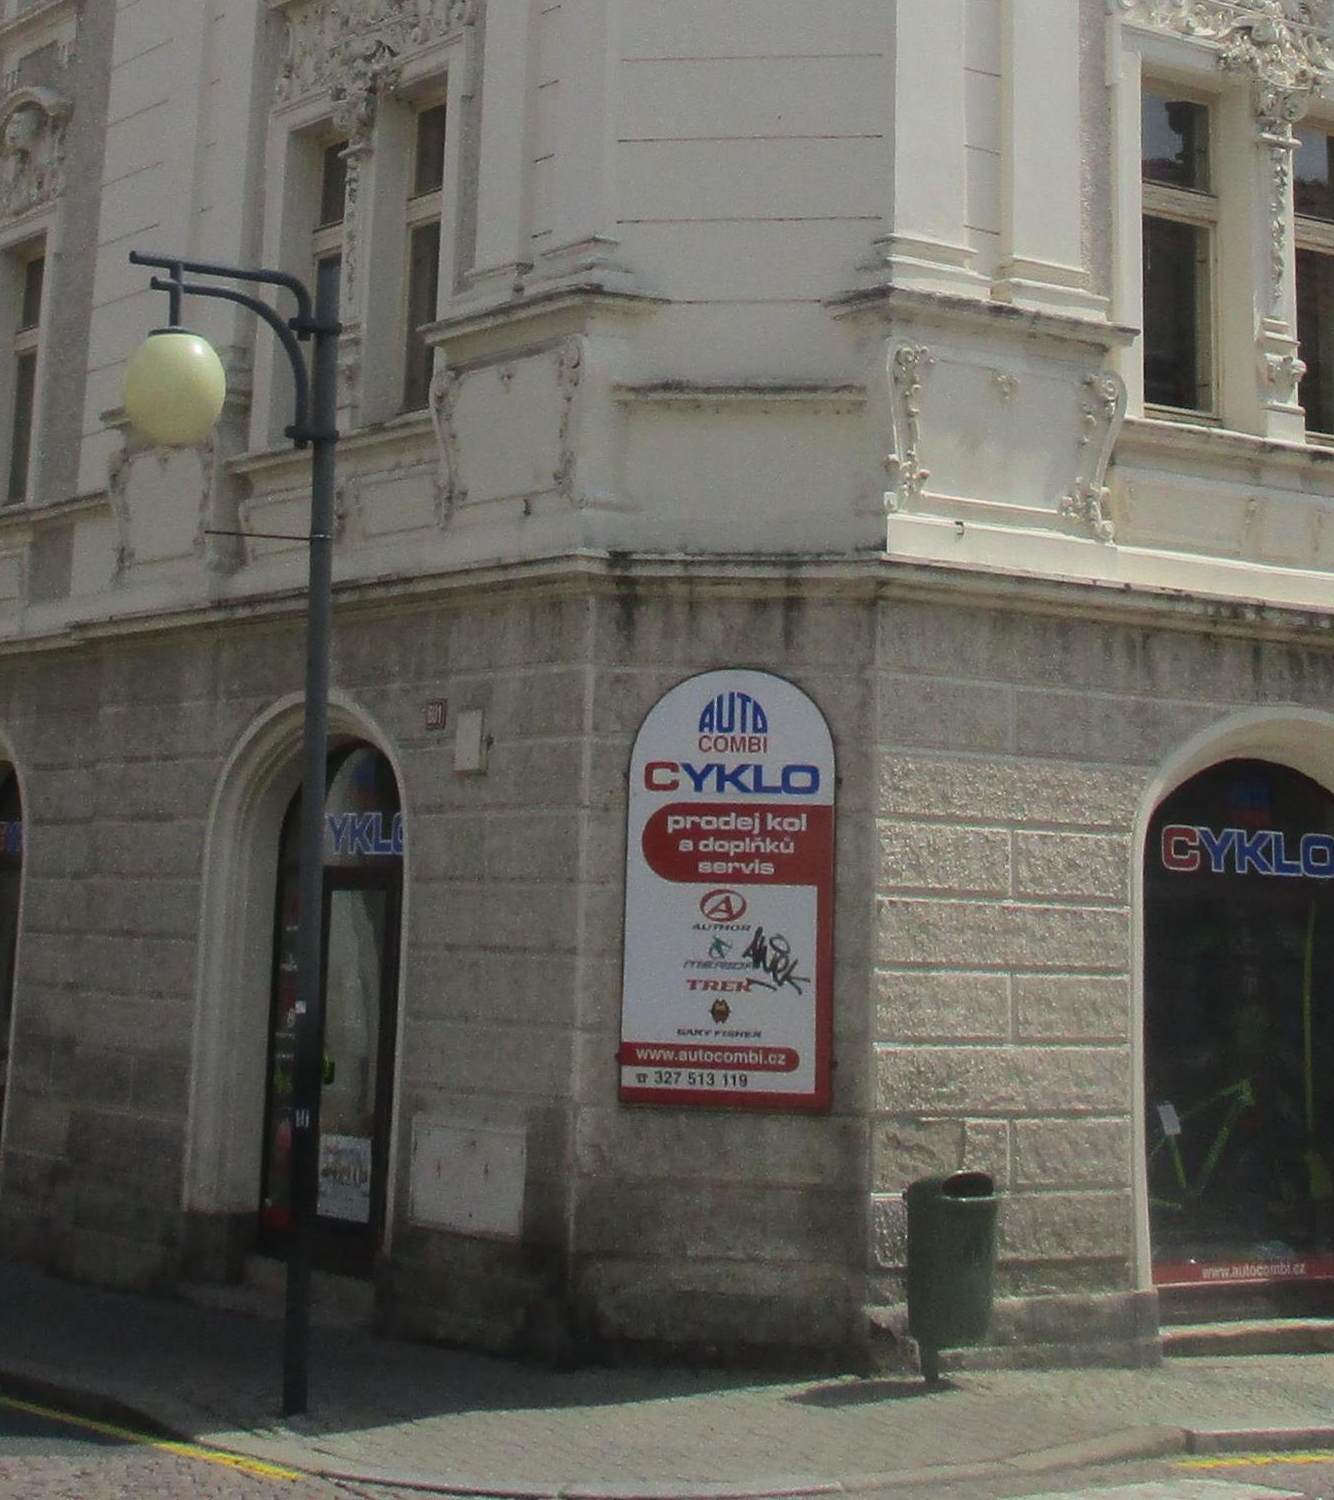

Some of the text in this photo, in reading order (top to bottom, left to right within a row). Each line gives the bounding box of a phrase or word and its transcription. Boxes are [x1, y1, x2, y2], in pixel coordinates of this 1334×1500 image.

[698, 691, 768, 733] AUTO
[698, 735, 767, 753] COMBI
[644, 761, 820, 795] CYKLO
[666, 812, 807, 834] prodej kol
[678, 835, 795, 856] a doplňků
[698, 859, 775, 875] servis
[691, 922, 752, 931] AUTHOR
[686, 978, 753, 992] TREK
[635, 1047, 786, 1066] www.autocombi.cz
[654, 1070, 748, 1087] 327 513 119
